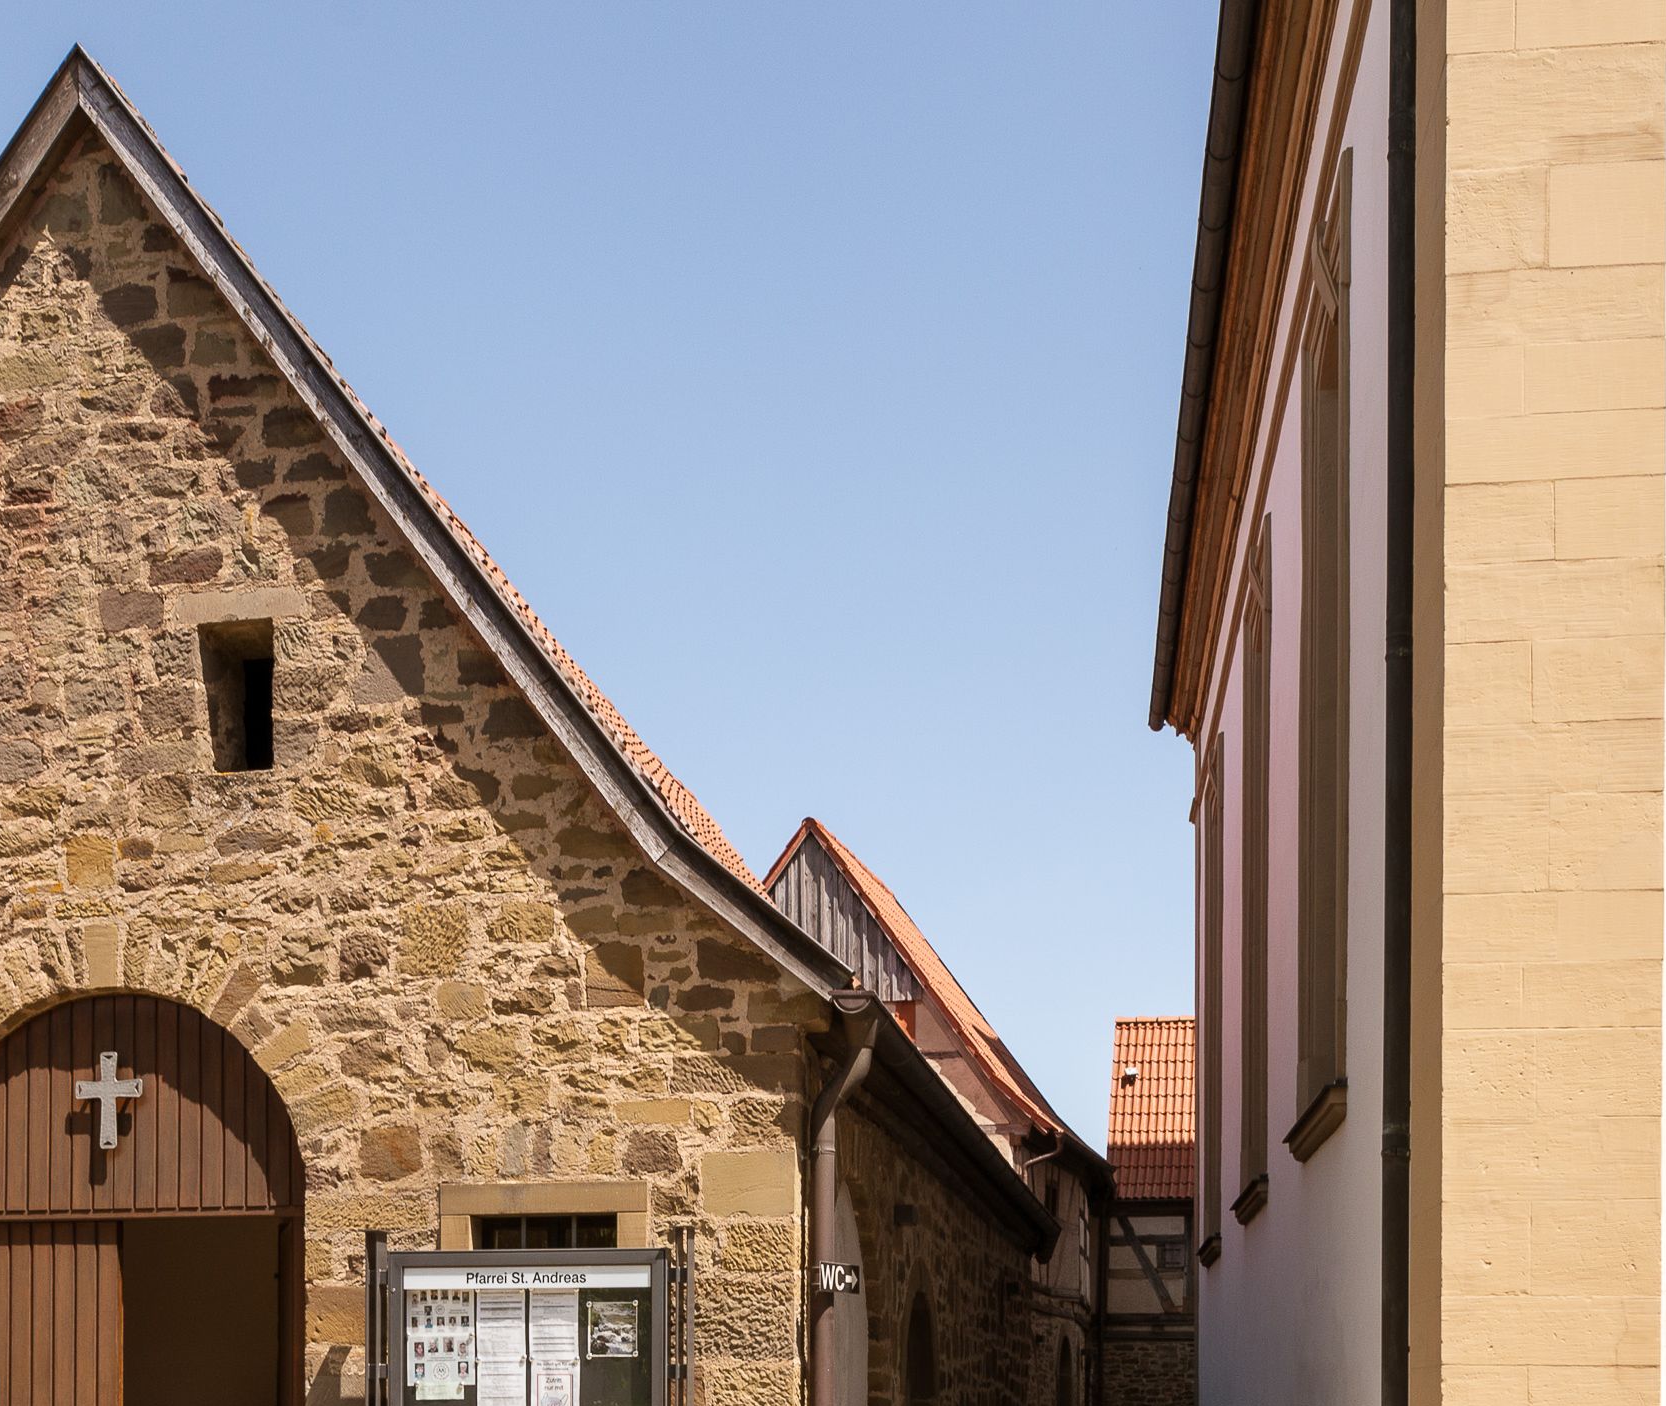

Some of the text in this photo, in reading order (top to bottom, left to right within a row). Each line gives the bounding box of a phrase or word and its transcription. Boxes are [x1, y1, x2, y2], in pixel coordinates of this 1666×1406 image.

[466, 1271, 587, 1284] Pfarrei St. Andreas
[821, 1264, 845, 1291] WC
